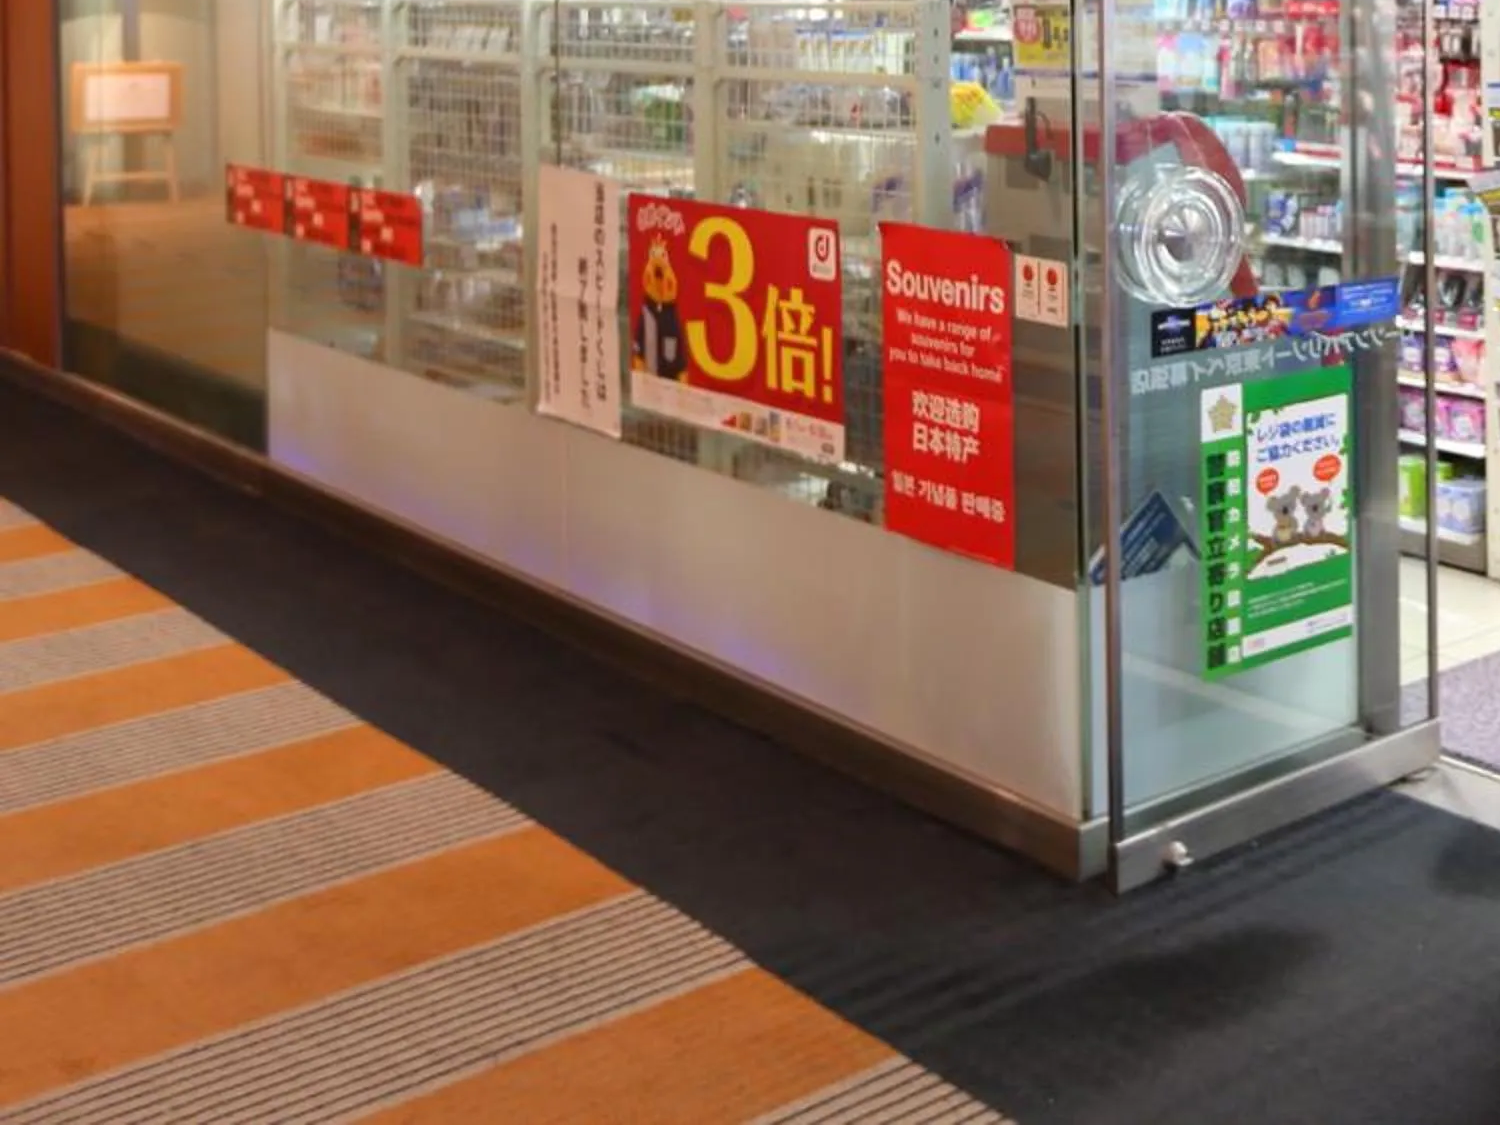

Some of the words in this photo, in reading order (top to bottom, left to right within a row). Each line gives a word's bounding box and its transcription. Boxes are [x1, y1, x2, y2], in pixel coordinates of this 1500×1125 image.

[886, 259, 1005, 315] Souvenirs
[911, 422, 981, 464] 日本特产
